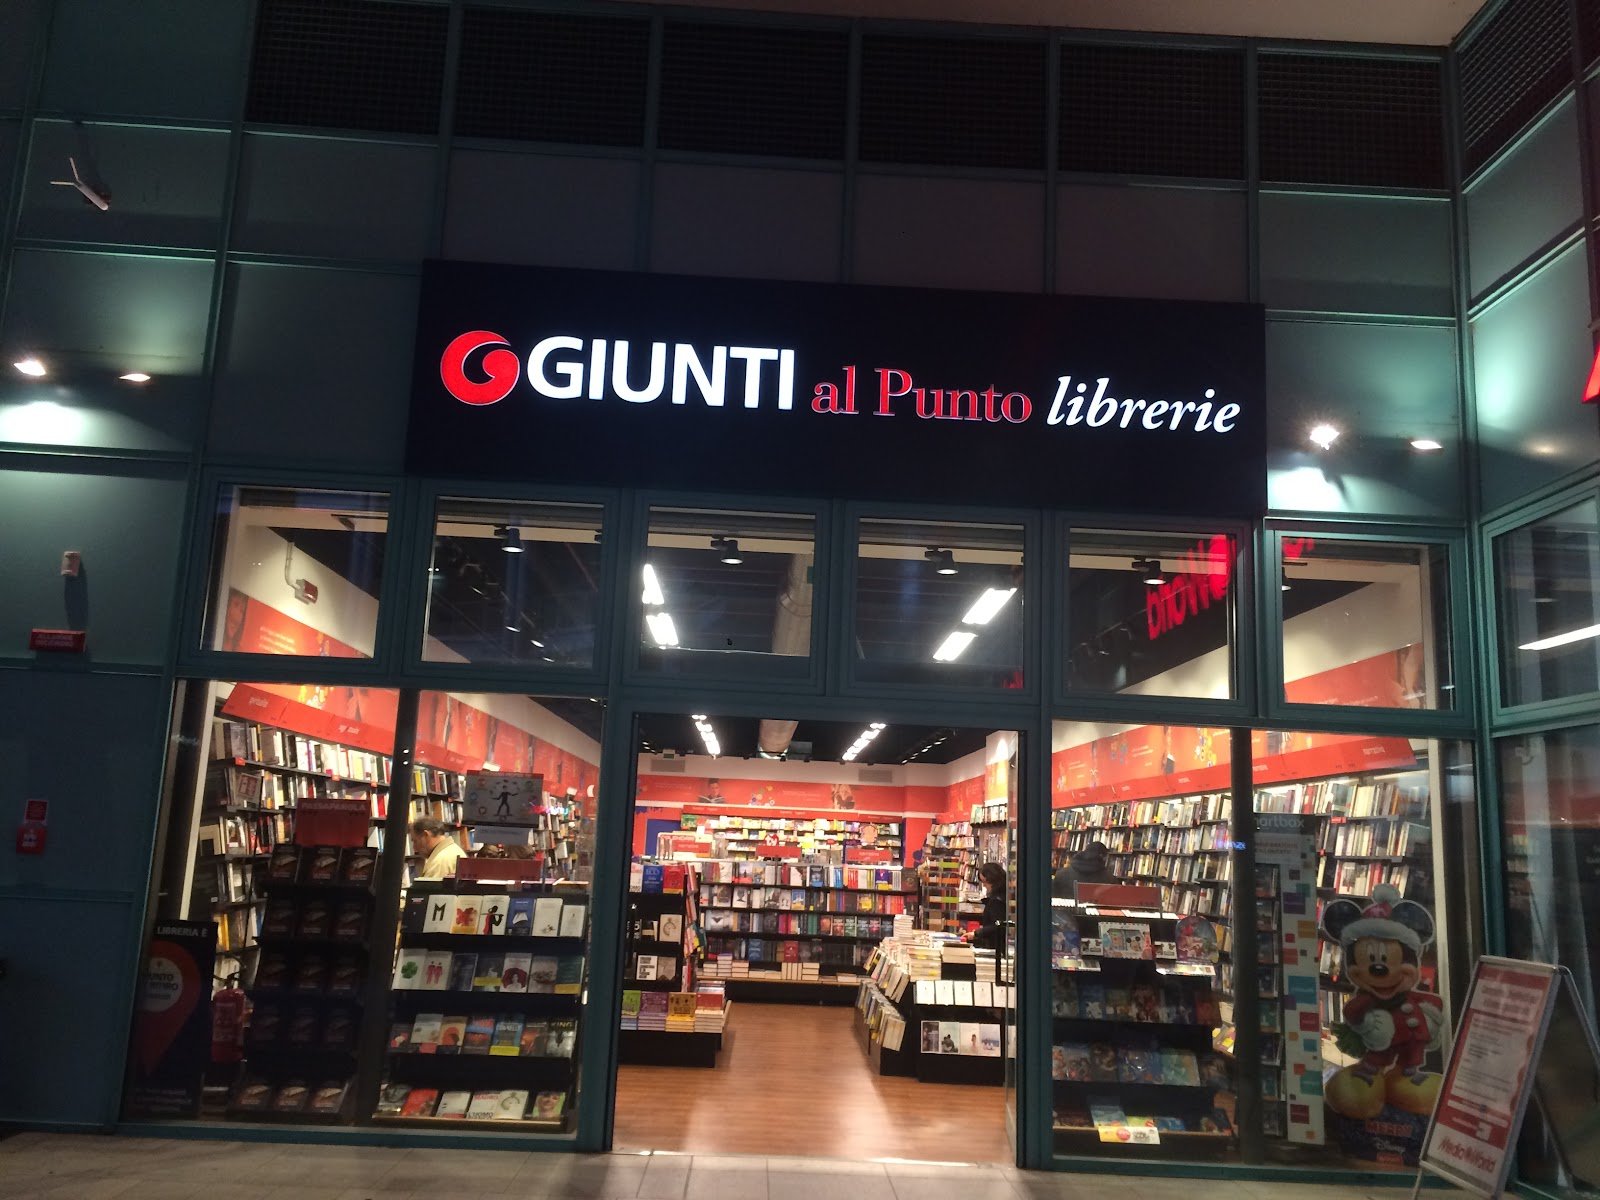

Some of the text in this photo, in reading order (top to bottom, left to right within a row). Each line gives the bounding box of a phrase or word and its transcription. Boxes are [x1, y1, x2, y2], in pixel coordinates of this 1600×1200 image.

[527, 336, 1241, 433] GIUNTI al Punto librerie
[157, 926, 199, 937] LIBRERIA
